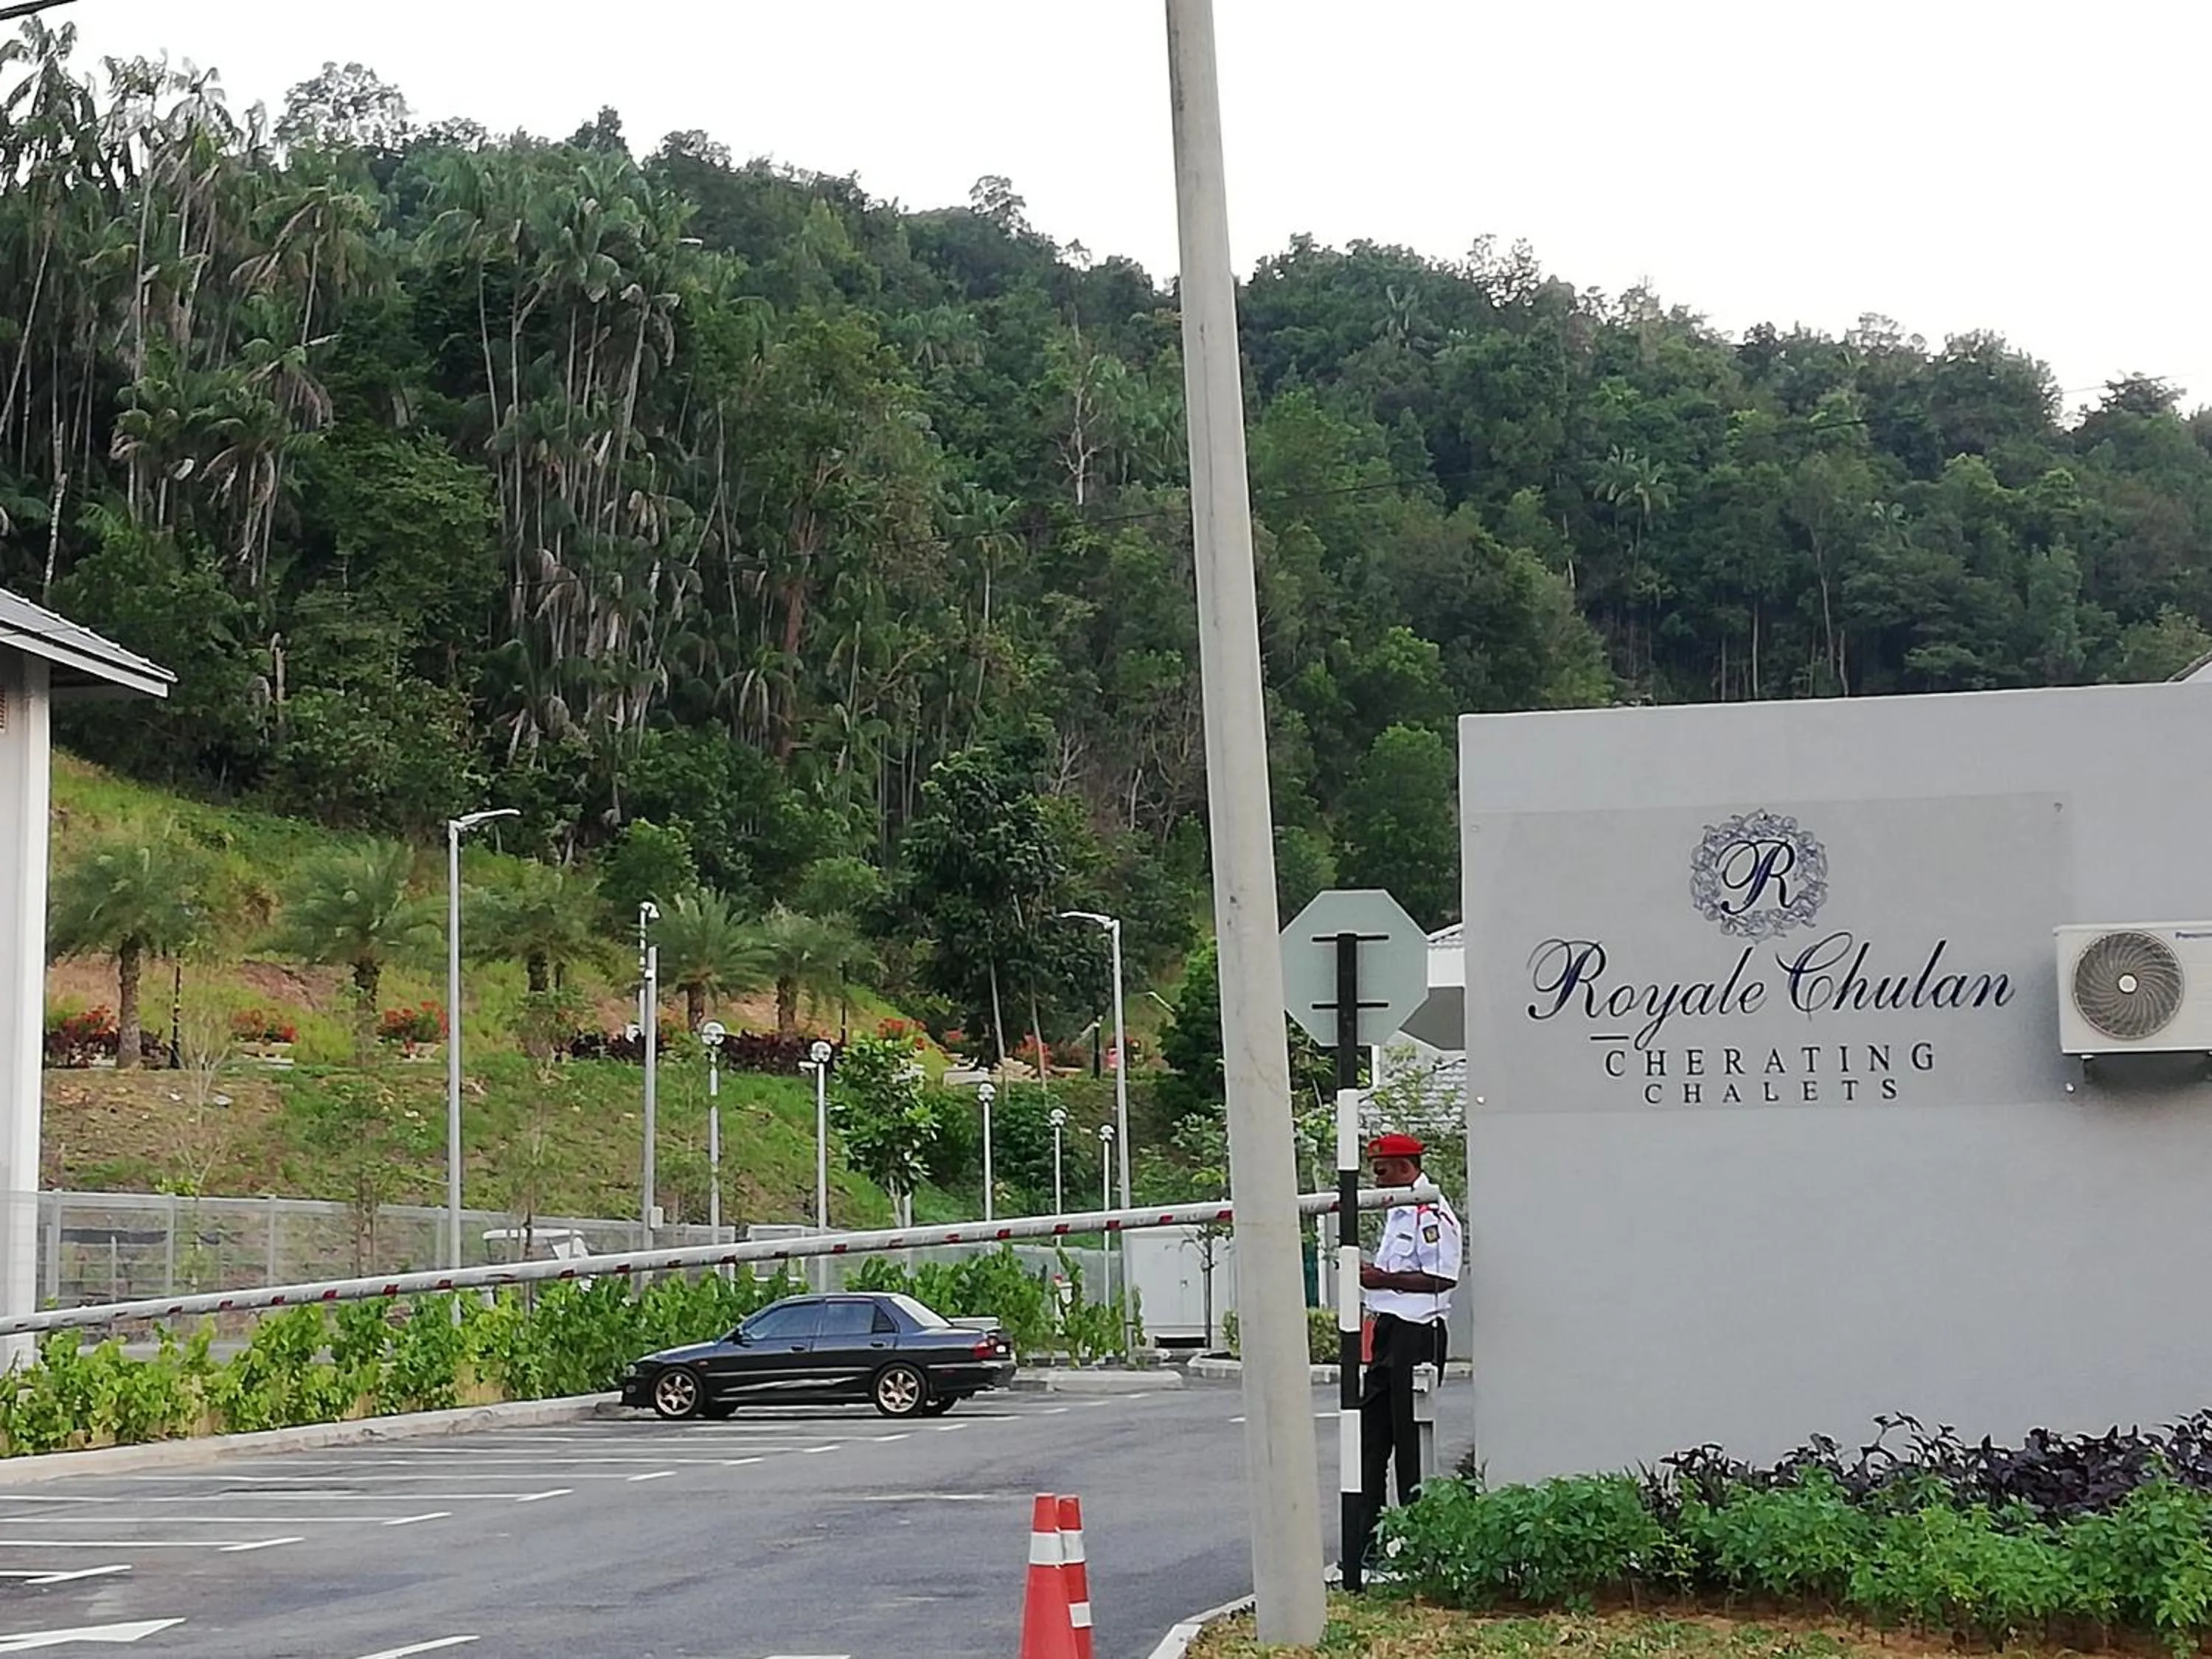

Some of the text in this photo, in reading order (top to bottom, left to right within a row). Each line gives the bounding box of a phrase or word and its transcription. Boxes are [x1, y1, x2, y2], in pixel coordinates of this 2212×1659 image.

[1527, 931, 2017, 1051] Royale Chulan
[1605, 1042, 1934, 1077] CHERATING
[1644, 1078, 1898, 1105] CHALETS
